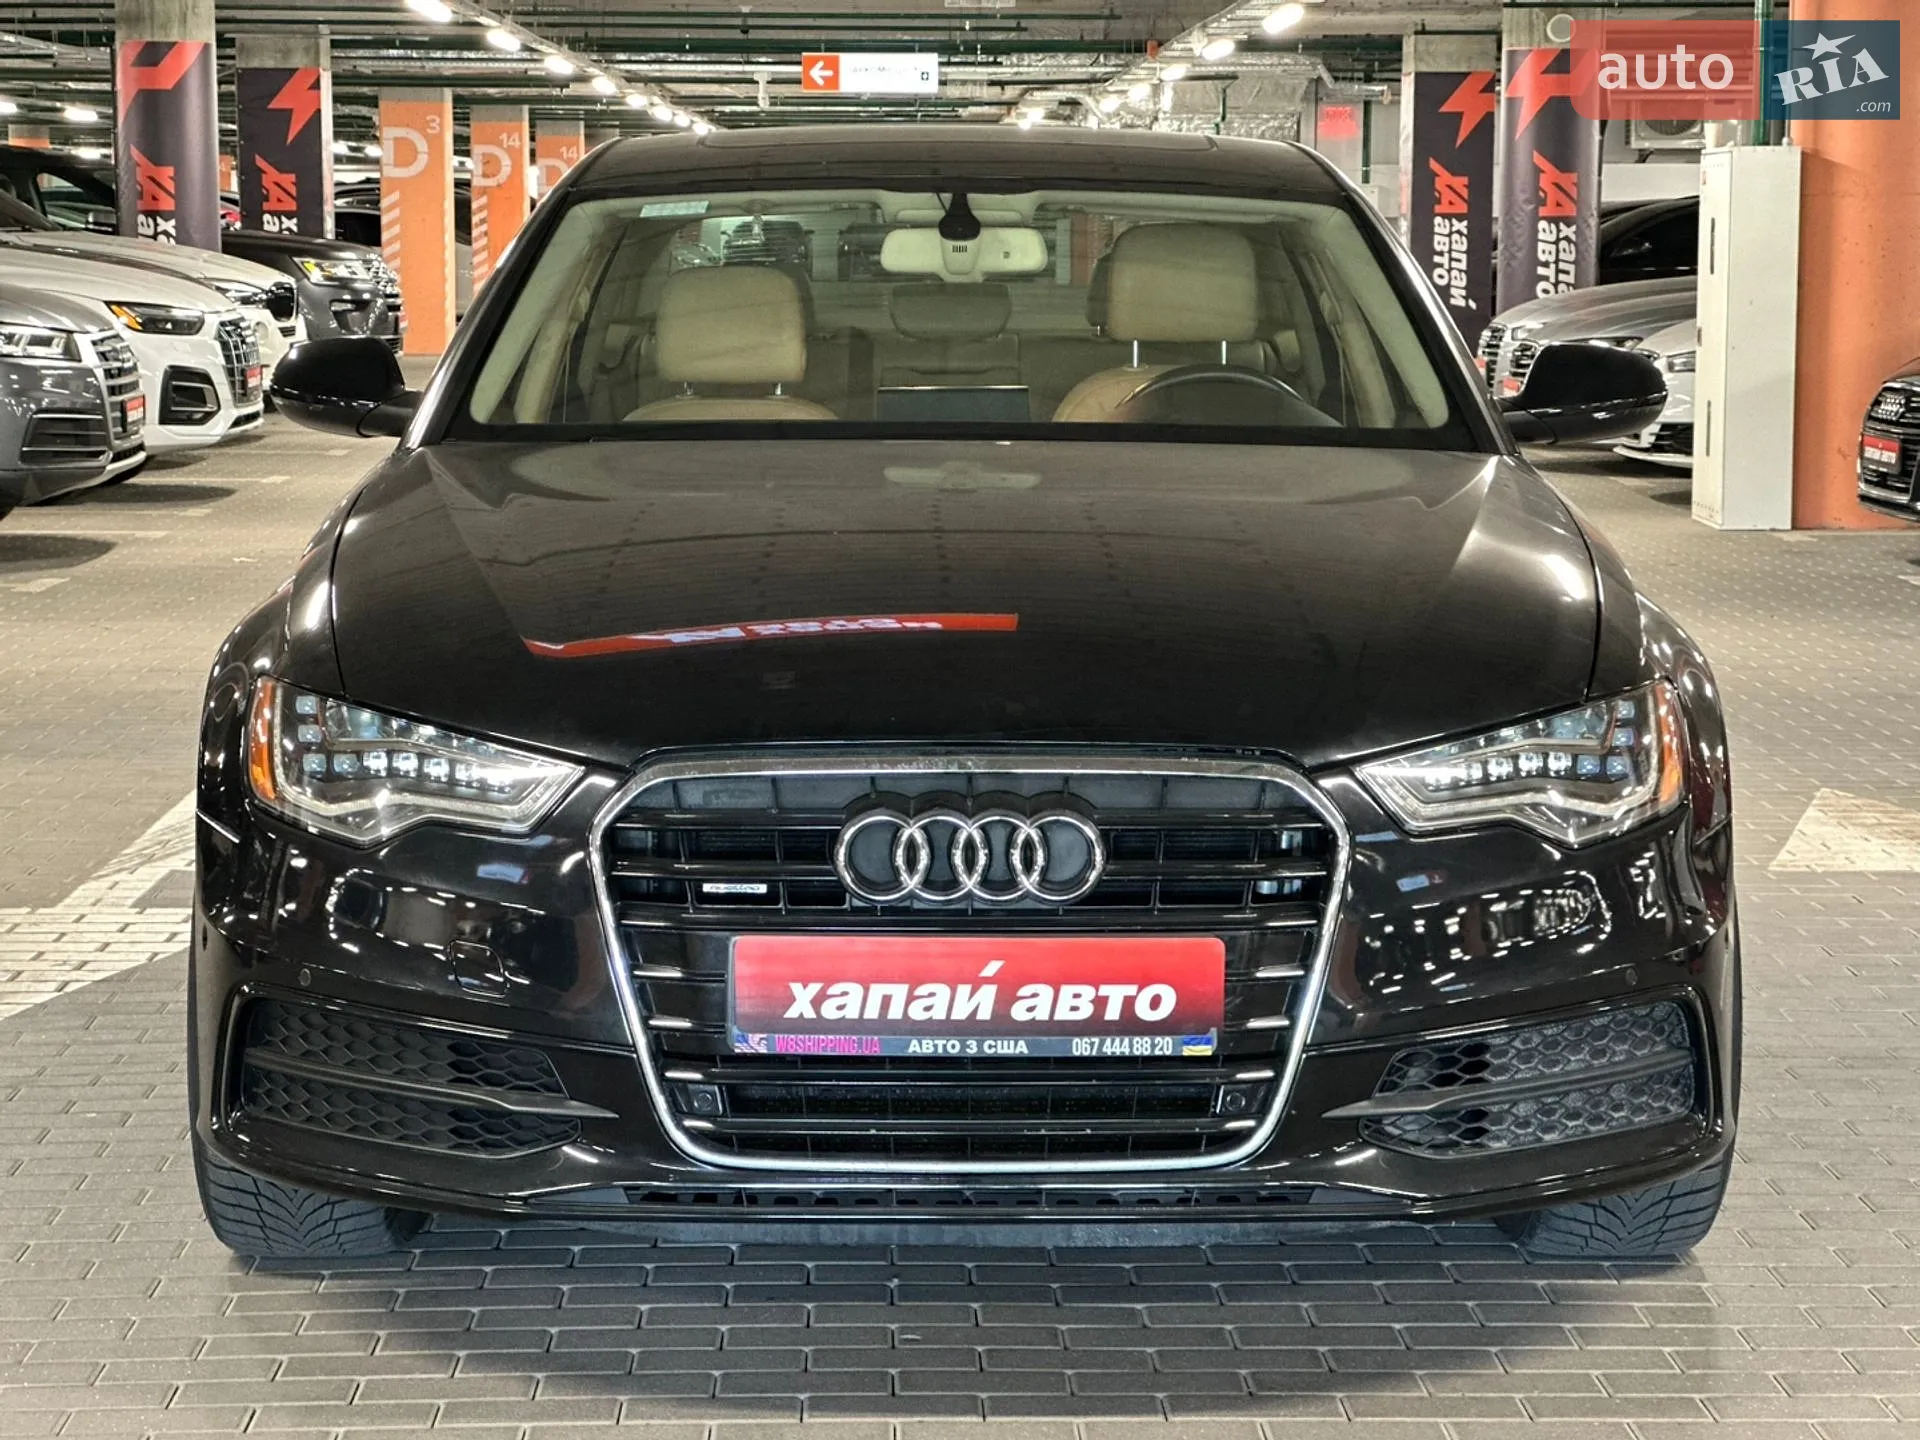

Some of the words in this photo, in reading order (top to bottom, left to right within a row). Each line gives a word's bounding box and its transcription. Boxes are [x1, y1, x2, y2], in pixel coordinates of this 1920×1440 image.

[382, 127, 428, 178] D
[426, 115, 440, 134] 3
[471, 144, 512, 187] D
[499, 132, 521, 149] 14
[1433, 216, 1450, 286] авто
[1450, 217, 1476, 310] хапай
[1536, 220, 1557, 299] авто
[783, 960, 1005, 1021] хапай
[1010, 983, 1177, 1021] авто
[775, 1034, 881, 1054] W8SHIPPING.UA
[908, 1039, 960, 1053] АВТО
[983, 1040, 1029, 1054] США
[1072, 1037, 1099, 1055] 067
[1102, 1037, 1131, 1055] 444
[1133, 1037, 1152, 1055] 88
[1154, 1037, 1173, 1055] 20
